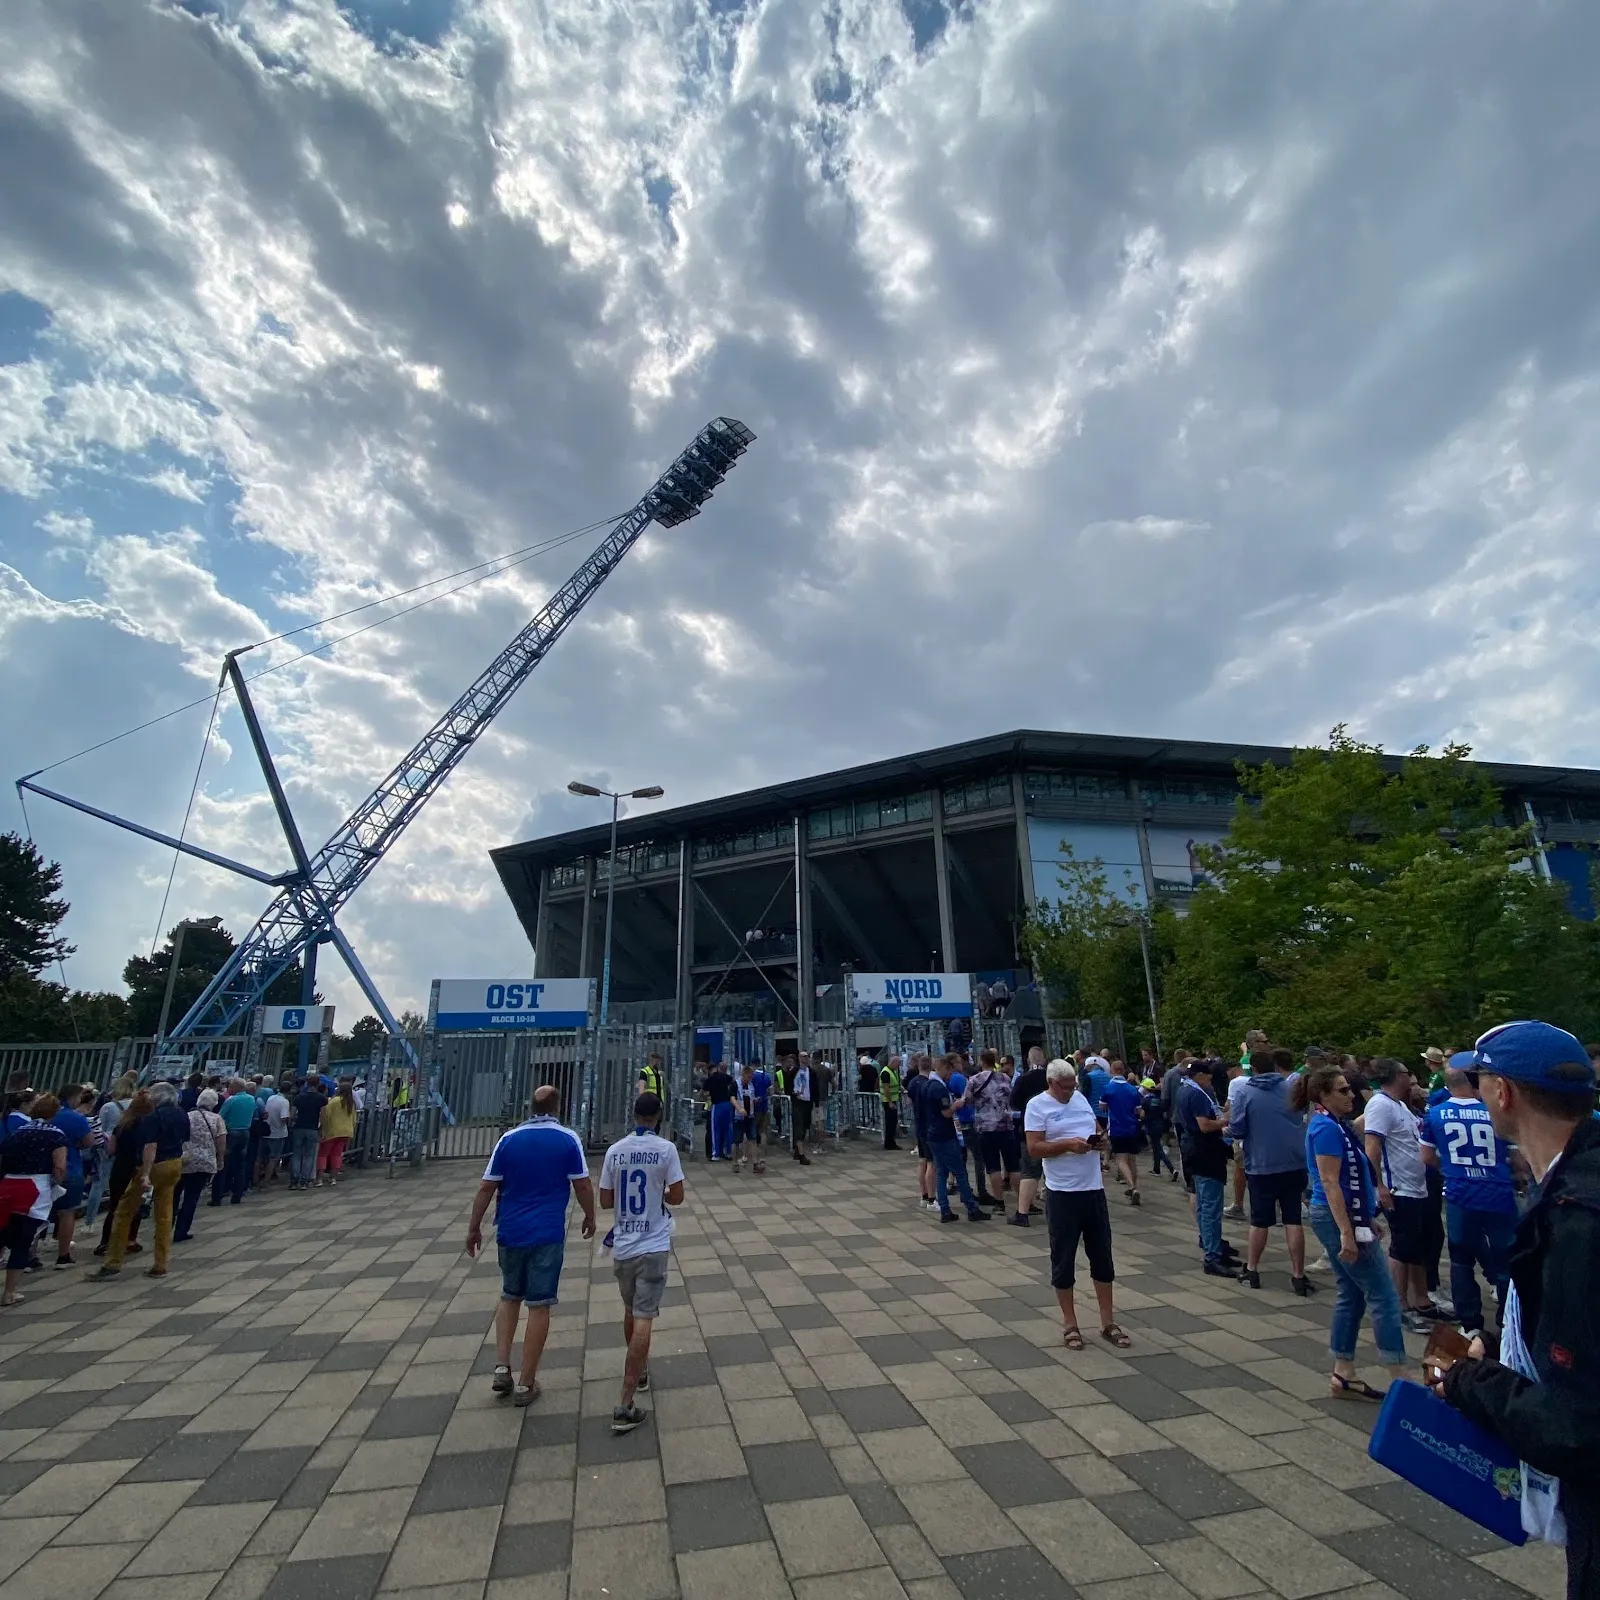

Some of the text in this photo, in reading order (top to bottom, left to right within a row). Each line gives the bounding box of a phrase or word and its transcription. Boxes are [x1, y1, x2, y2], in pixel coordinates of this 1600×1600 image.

[486, 984, 545, 1009] OST
[885, 979, 942, 999] NORD
[491, 1015, 515, 1023] BLOCK
[1440, 1108, 1458, 1120] F.C.
[1444, 1122, 1497, 1167] 29
[630, 1152, 659, 1165] HANSA
[620, 1169, 647, 1216] 13
